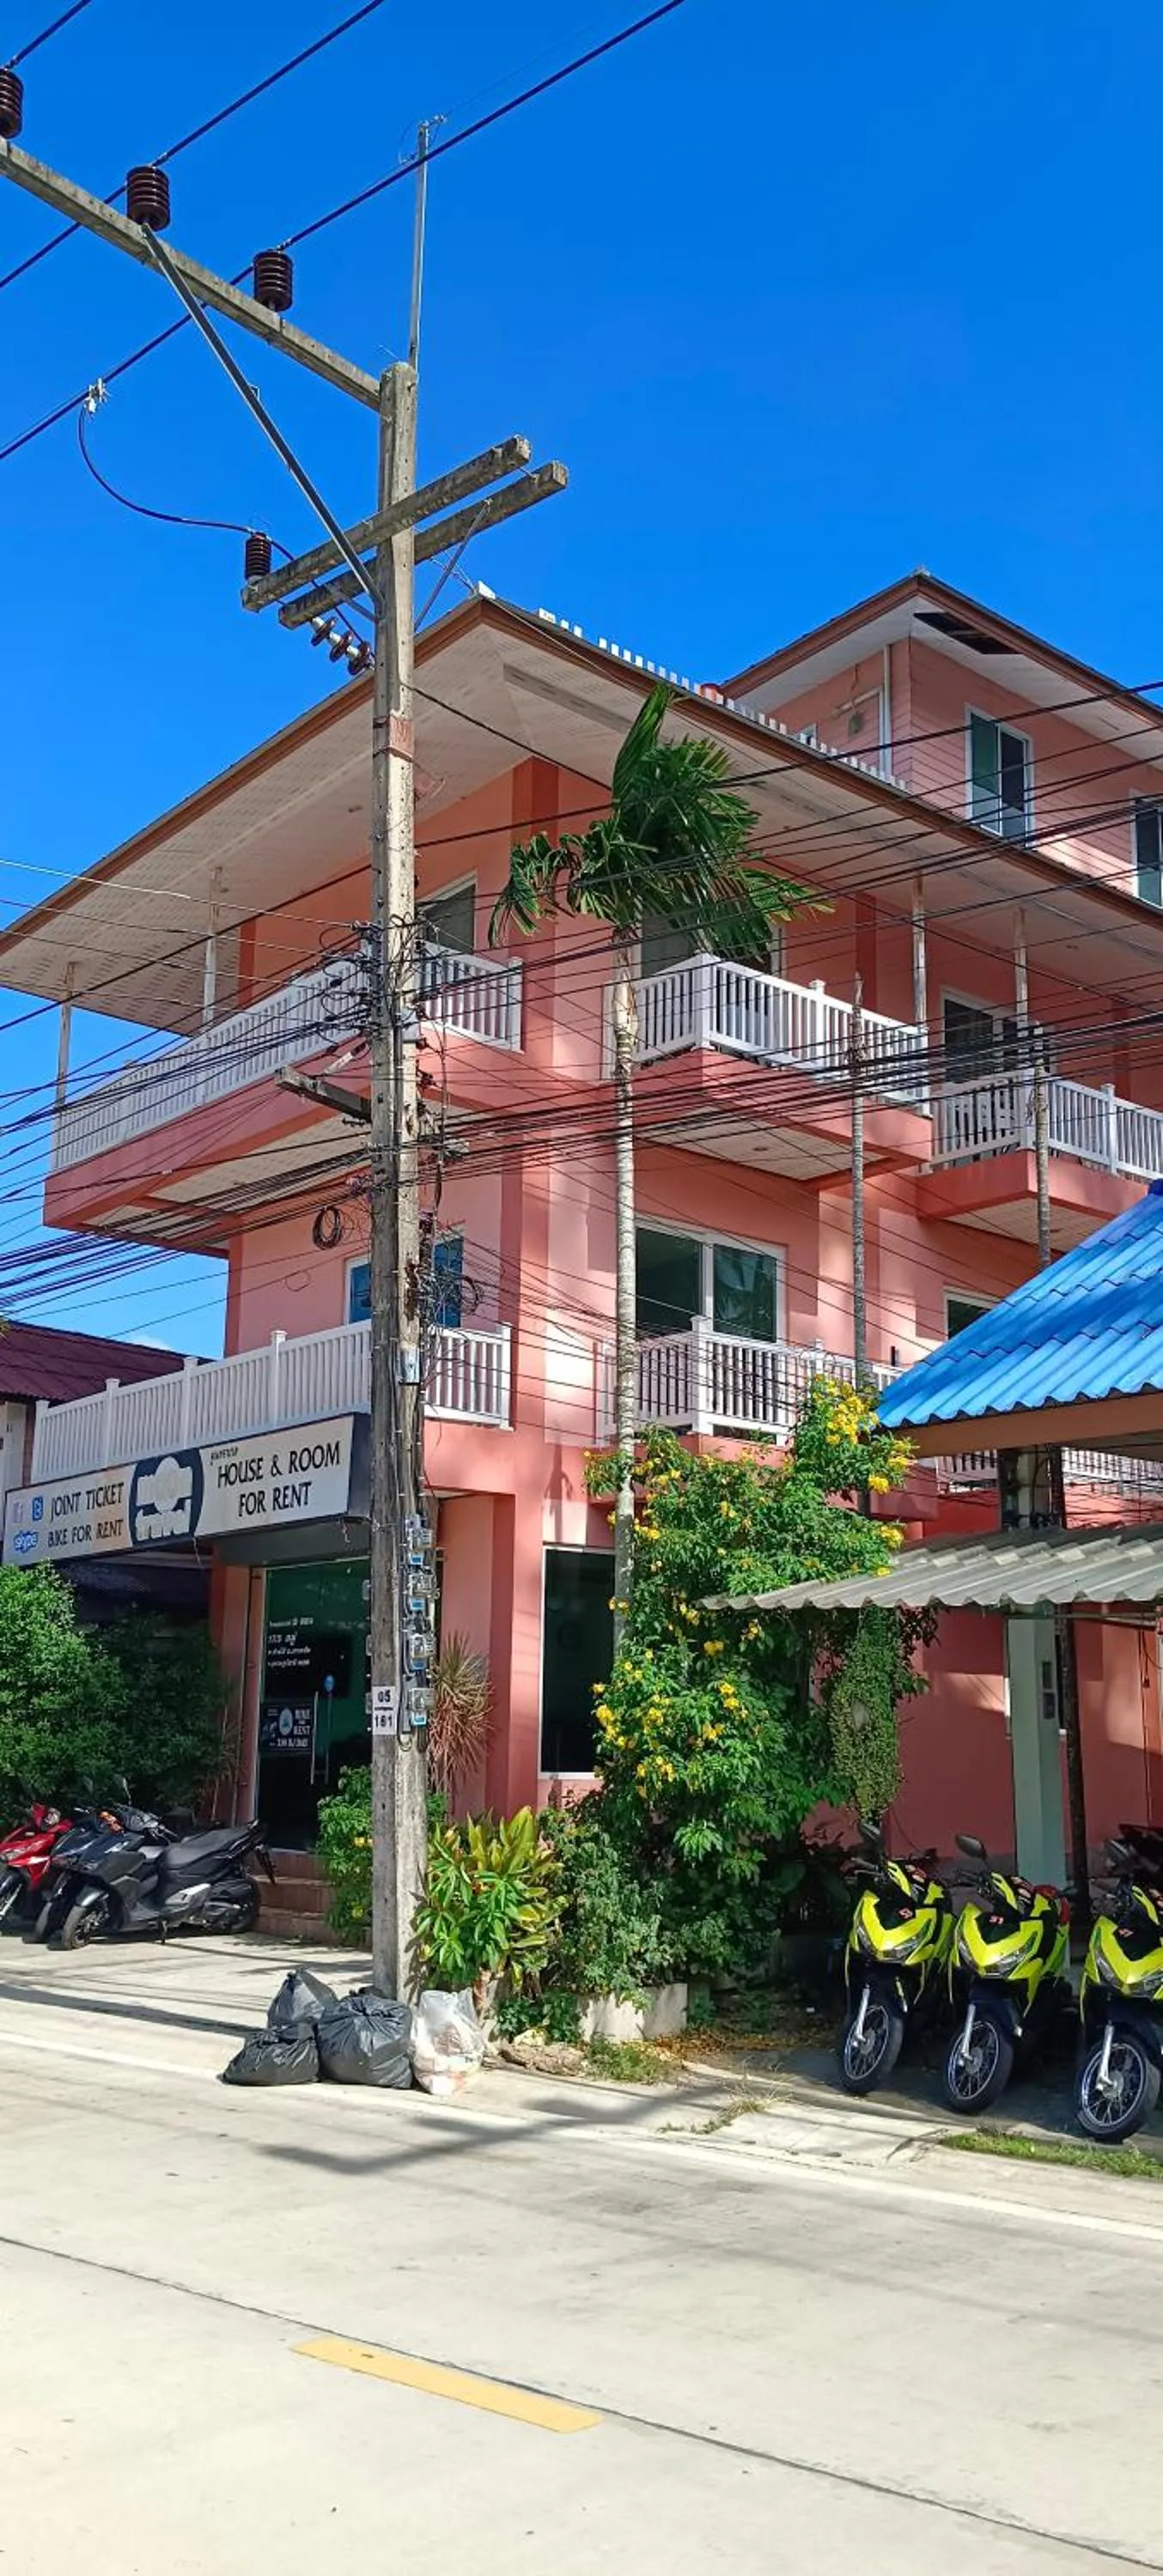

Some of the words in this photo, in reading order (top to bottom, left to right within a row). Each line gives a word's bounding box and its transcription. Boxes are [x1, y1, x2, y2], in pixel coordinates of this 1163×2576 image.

[217, 1457, 264, 1488] HOUSE
[271, 1454, 283, 1478] &
[289, 1441, 340, 1473] ROOM
[50, 1492, 82, 1522] JOINT
[85, 1482, 125, 1510] TICKET
[239, 1490, 266, 1516] FOR
[272, 1481, 312, 1511] RENT
[47, 1528, 68, 1547] BIKE
[71, 1525, 92, 1544] FOR
[95, 1519, 124, 1540] RENT
